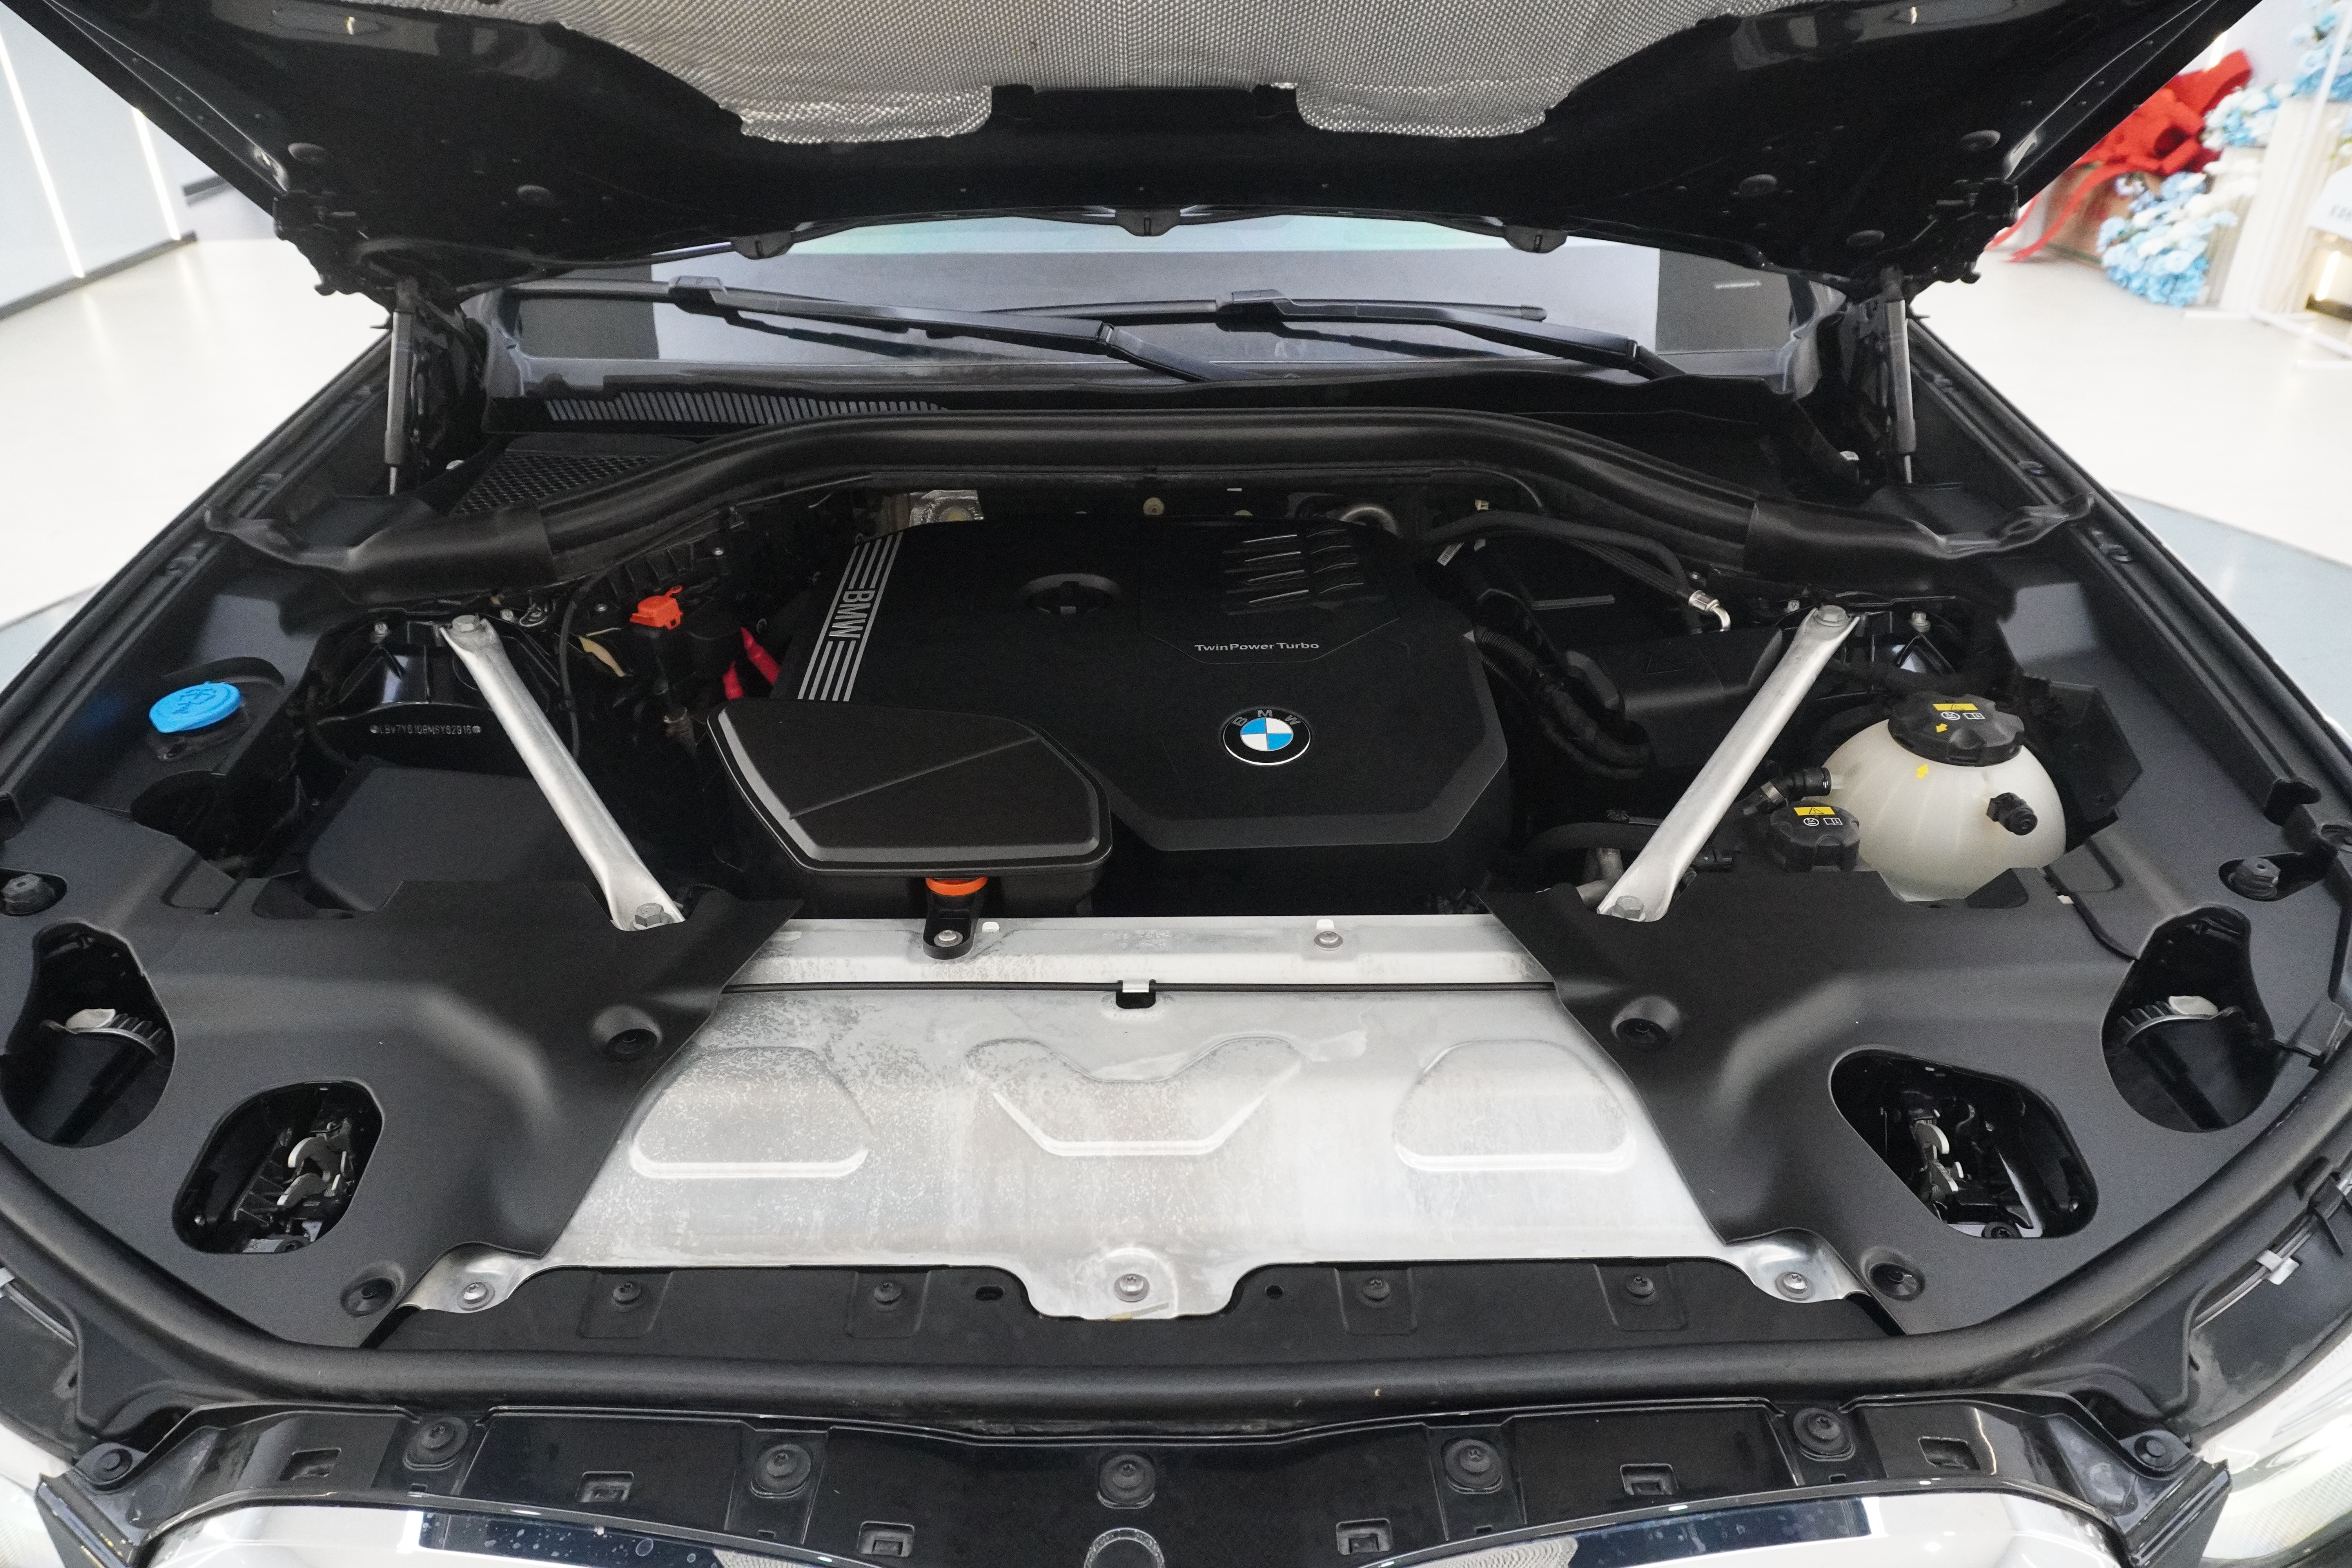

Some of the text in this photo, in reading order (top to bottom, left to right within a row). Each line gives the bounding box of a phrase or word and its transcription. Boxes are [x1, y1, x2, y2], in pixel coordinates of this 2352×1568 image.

[828, 590, 875, 638] BMW
[1194, 643, 1274, 652] TwinPower
[1231, 710, 1301, 727] BMW
